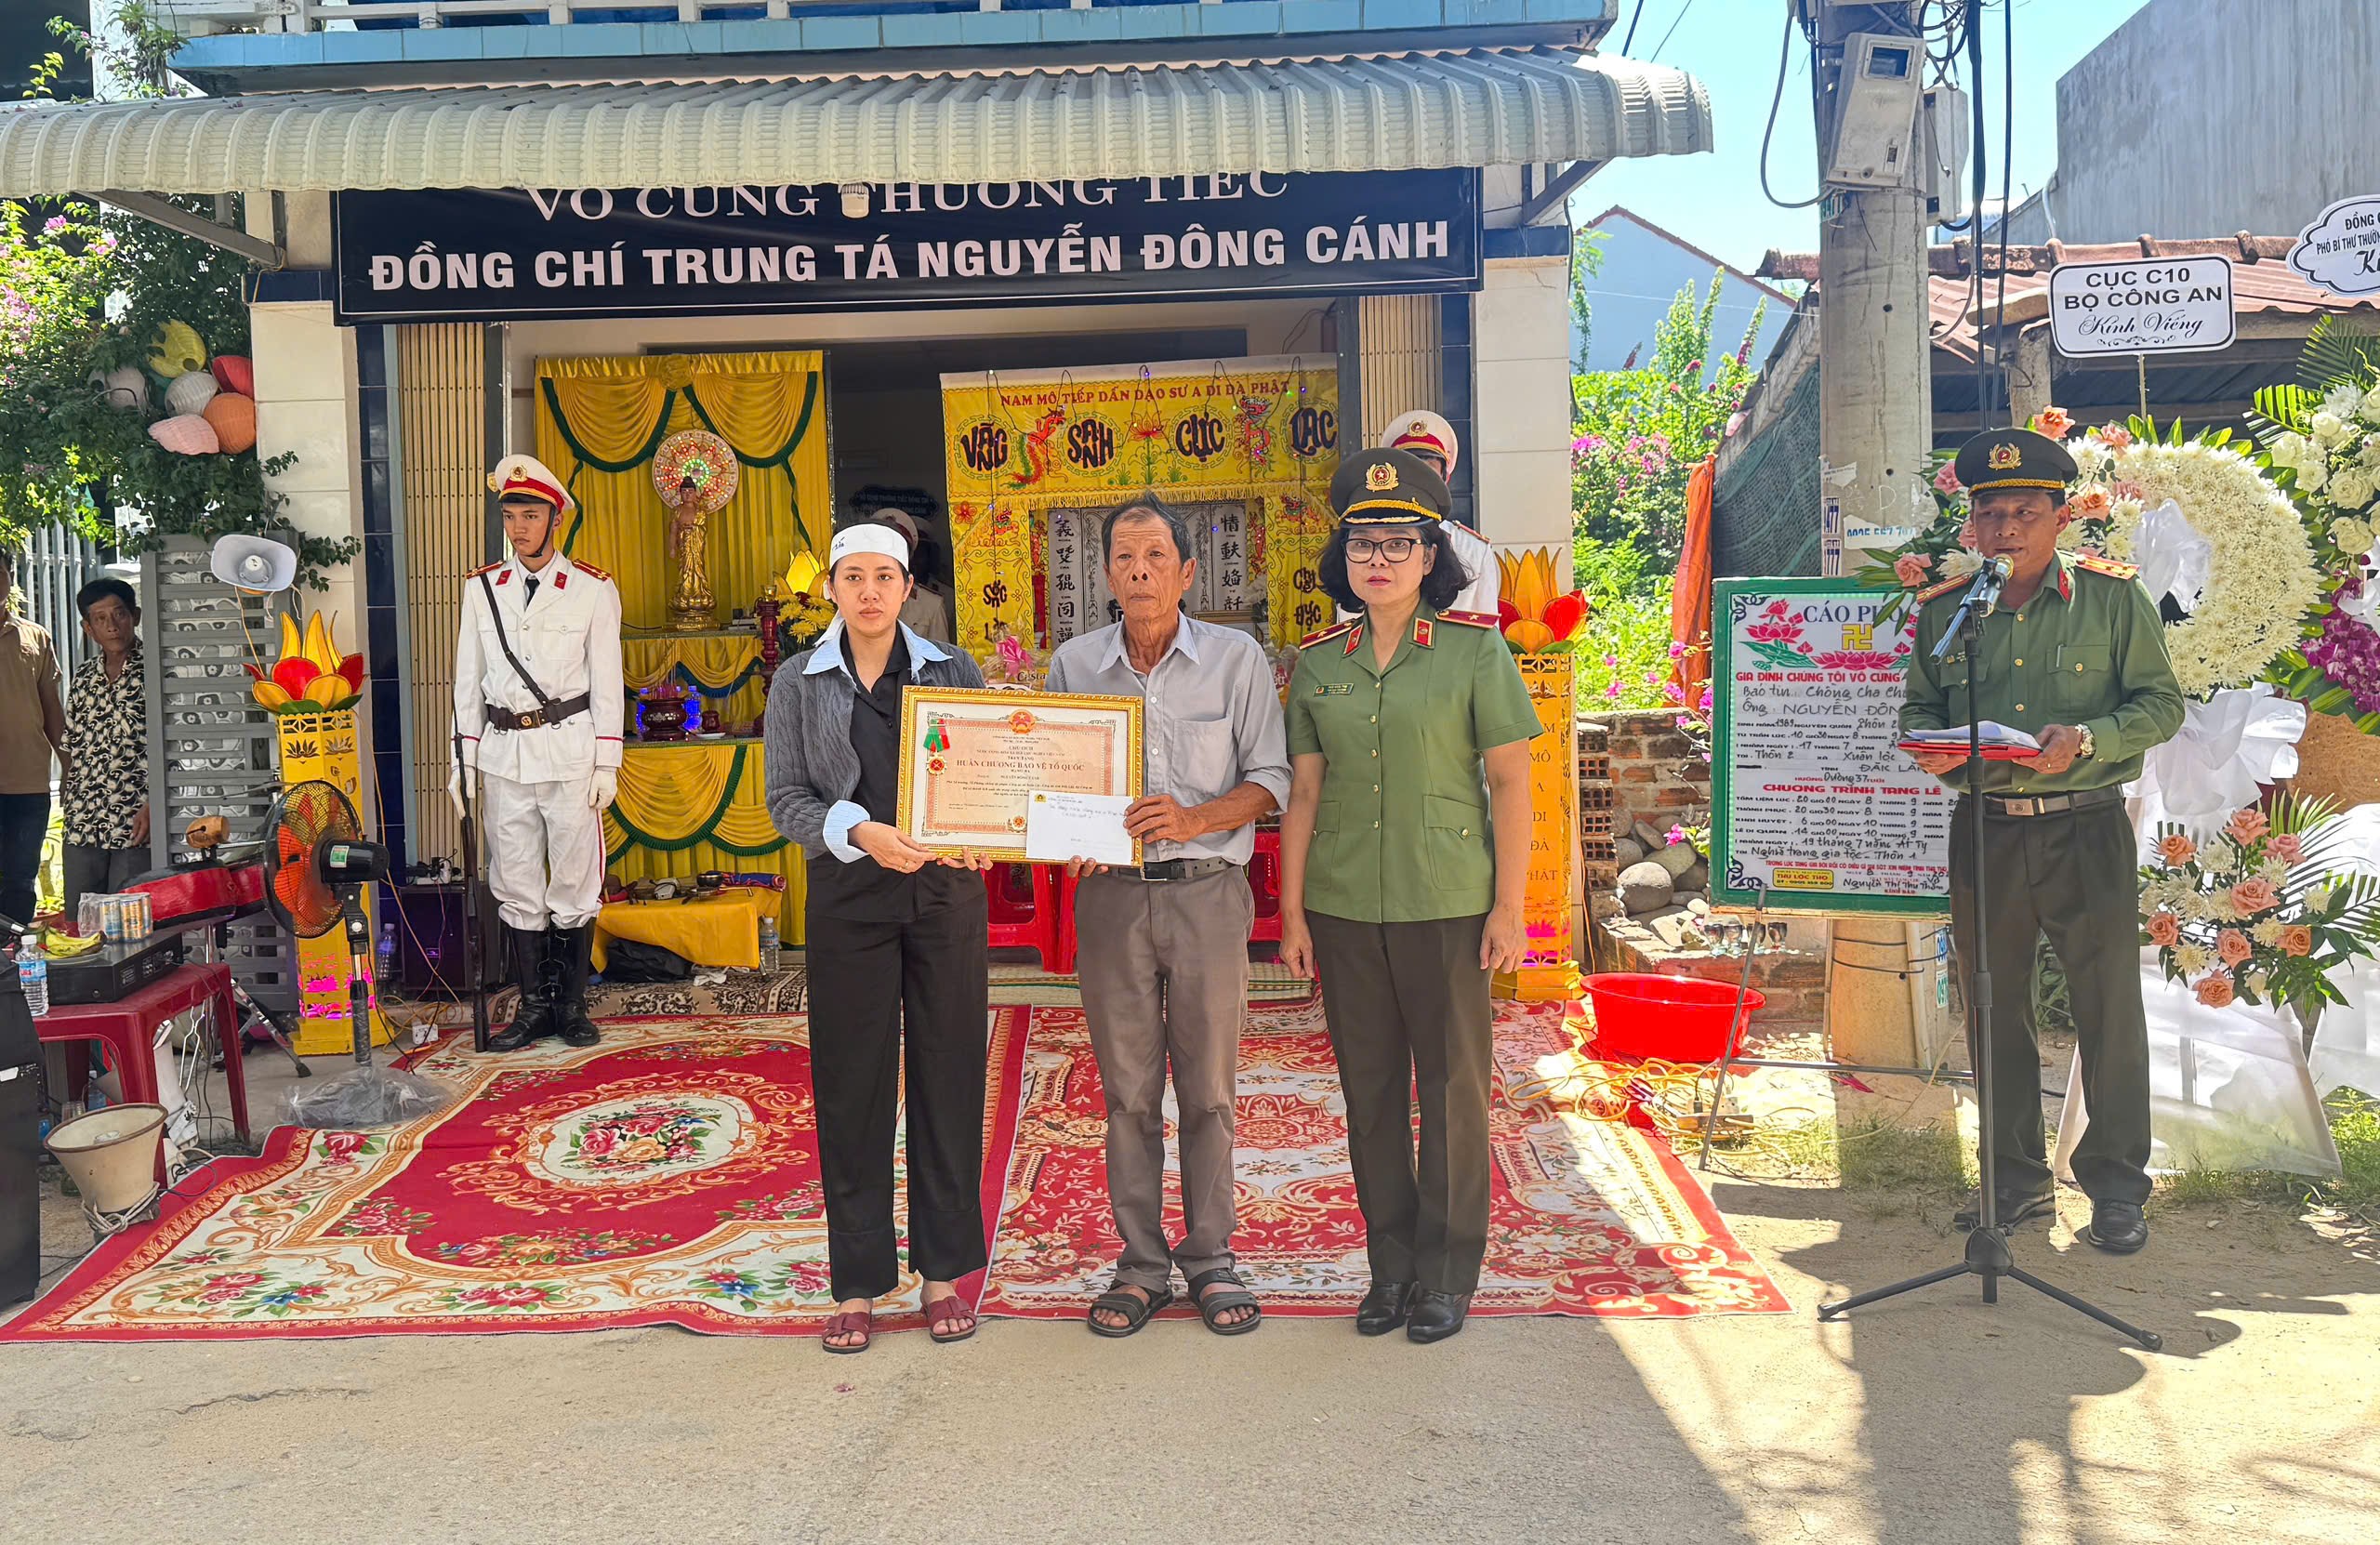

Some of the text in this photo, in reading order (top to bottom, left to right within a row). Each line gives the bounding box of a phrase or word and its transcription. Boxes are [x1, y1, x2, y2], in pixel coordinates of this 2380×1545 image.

[2345, 211, 2374, 231] ĐỒNG
[368, 215, 1448, 291] ĐỒNG CHÍ TRUNG TÁ NGUYỄN ĐÔNG CÁNH
[2316, 233, 2357, 255] PHÓ BÍ THƯ
[2086, 268, 2190, 291] CỤC C10
[2064, 286, 2223, 311] BỘ CÔNG AN
[1001, 395, 1033, 406] NAM
[1037, 391, 1057, 404] MÔ
[1062, 387, 1094, 403] TIẾP
[1170, 384, 1188, 398] SƯ
[1192, 387, 1201, 397] A
[1250, 379, 1289, 395] PHẬT
[1804, 601, 1849, 622] CÁO
[1736, 672, 1752, 682] GIA
[1783, 699, 1856, 715] NGUYỄN
[1755, 749, 1781, 759] Thôn
[1880, 786, 1920, 795] TANG
